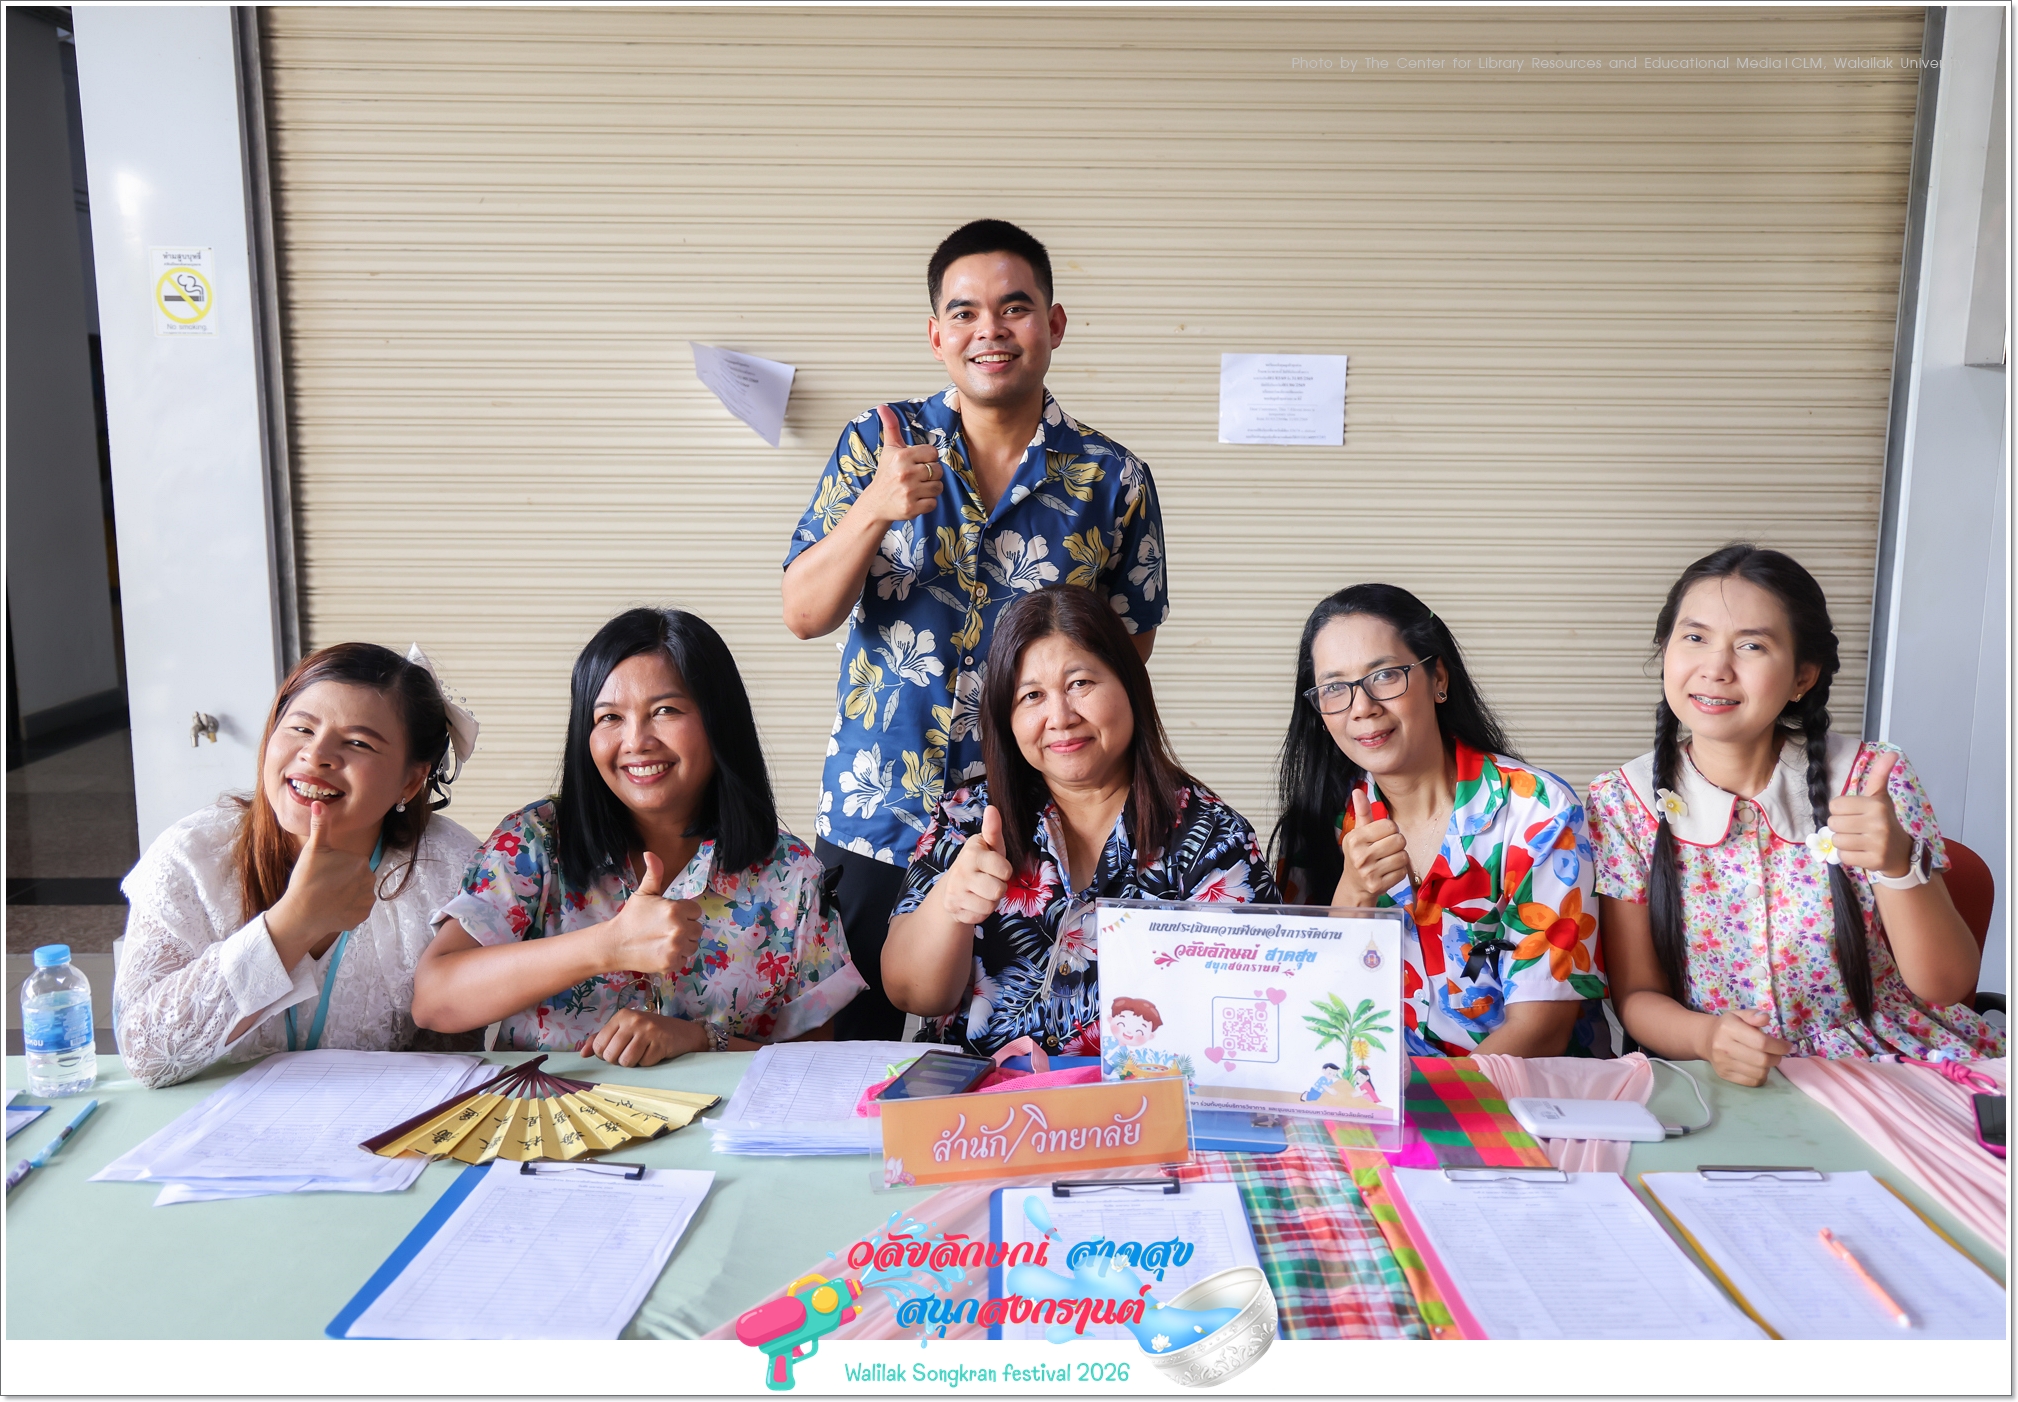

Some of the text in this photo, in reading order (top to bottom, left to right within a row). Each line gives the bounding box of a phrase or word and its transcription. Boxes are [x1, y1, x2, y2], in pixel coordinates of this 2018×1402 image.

[166, 323, 177, 331] No
[1174, 941, 1261, 960] วลัยลักษณ์
[1204, 960, 1281, 975] สนุกสงกรานต์
[932, 1095, 1148, 1164] สำนัก/วิทยาลัย
